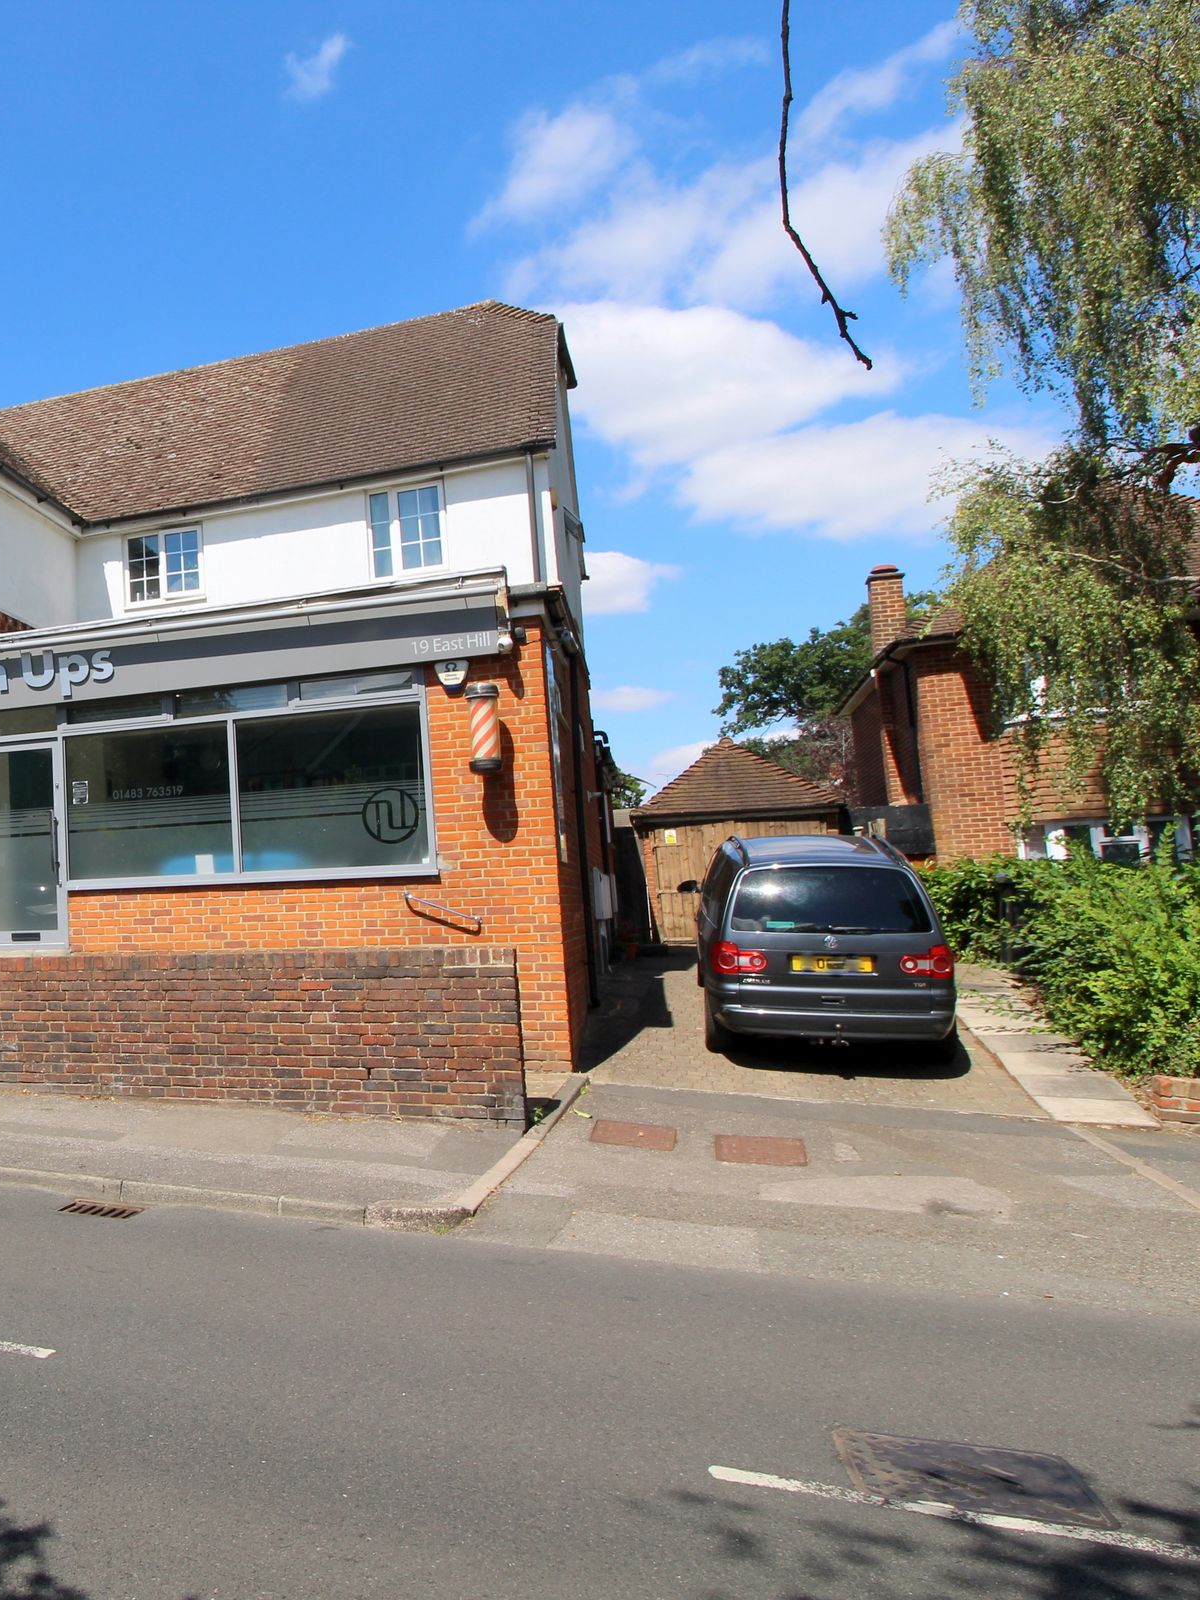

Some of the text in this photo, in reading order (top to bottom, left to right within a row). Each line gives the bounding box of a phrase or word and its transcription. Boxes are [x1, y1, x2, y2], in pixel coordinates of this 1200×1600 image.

[411, 631, 491, 655] 19 East Hill
[20, 650, 115, 701] Ups
[112, 785, 184, 800] 01483 763519
